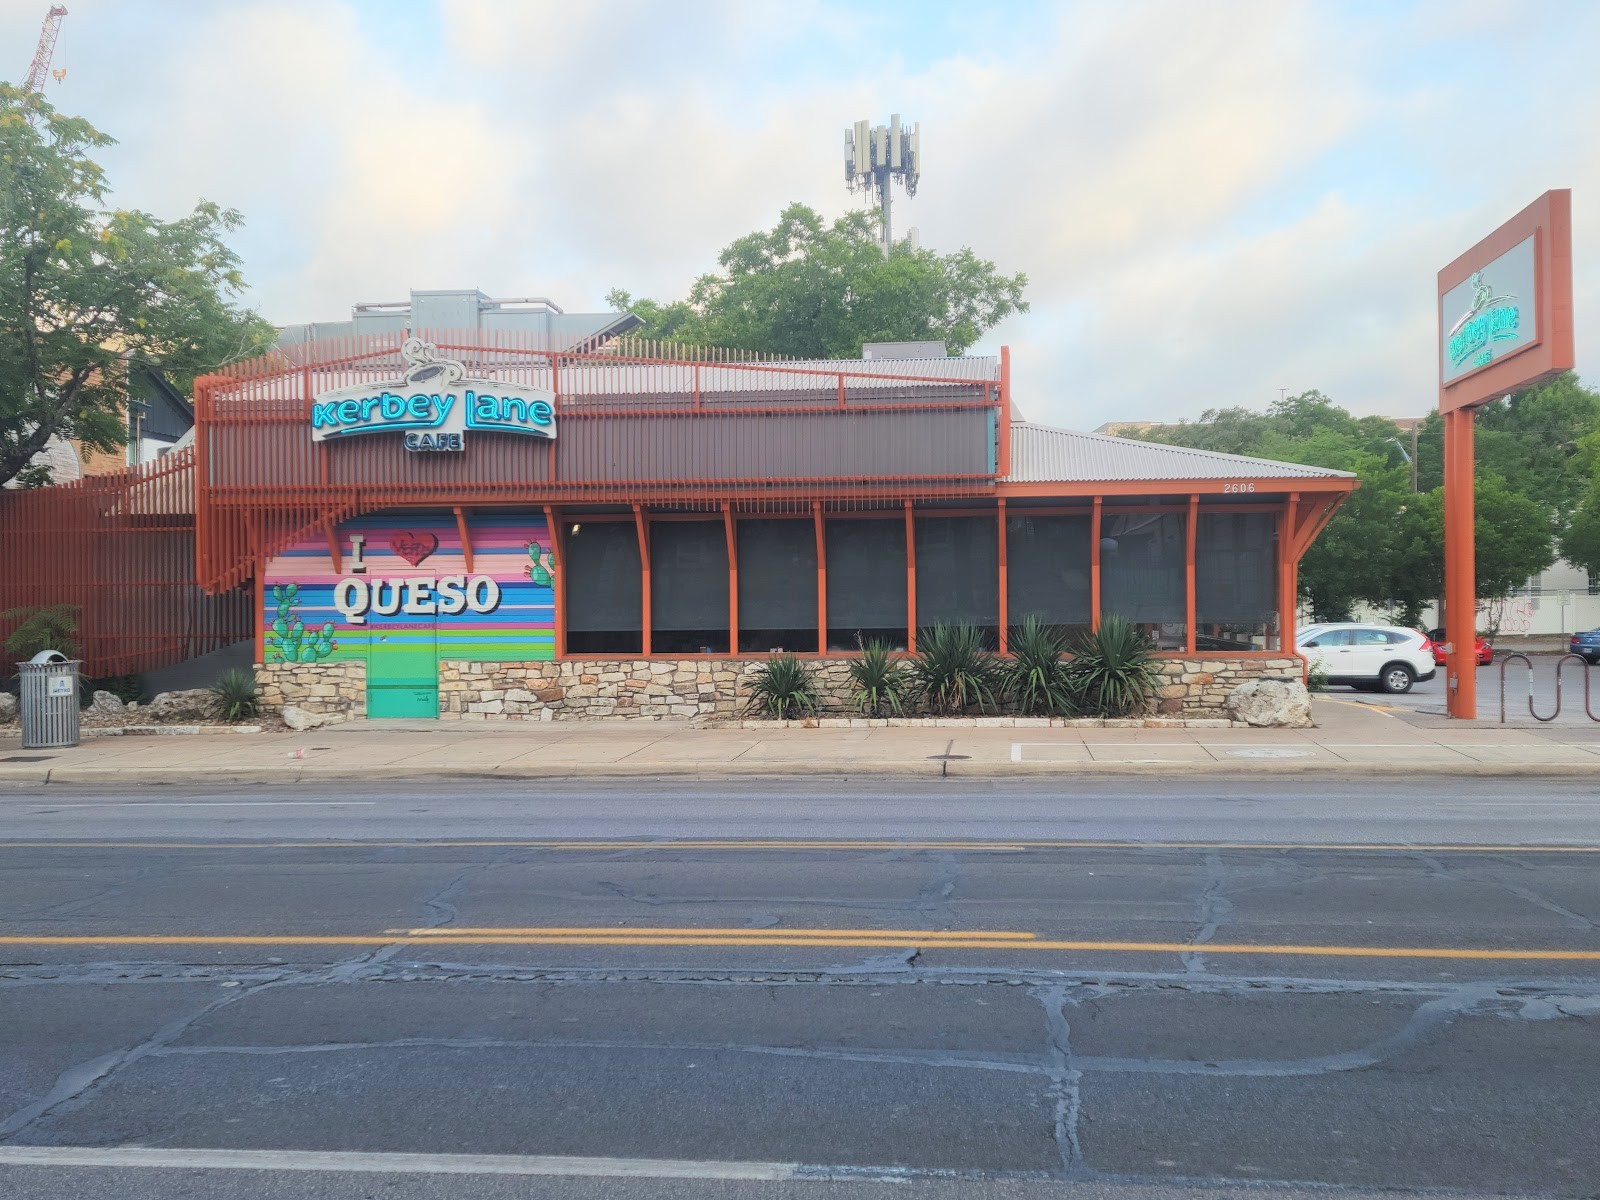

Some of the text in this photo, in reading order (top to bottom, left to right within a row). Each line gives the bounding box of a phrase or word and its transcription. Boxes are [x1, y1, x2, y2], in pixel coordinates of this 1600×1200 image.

[404, 432, 462, 450] CAFE
[1224, 483, 1255, 493] 2606
[350, 534, 366, 572] I
[333, 574, 501, 624] QUESO
